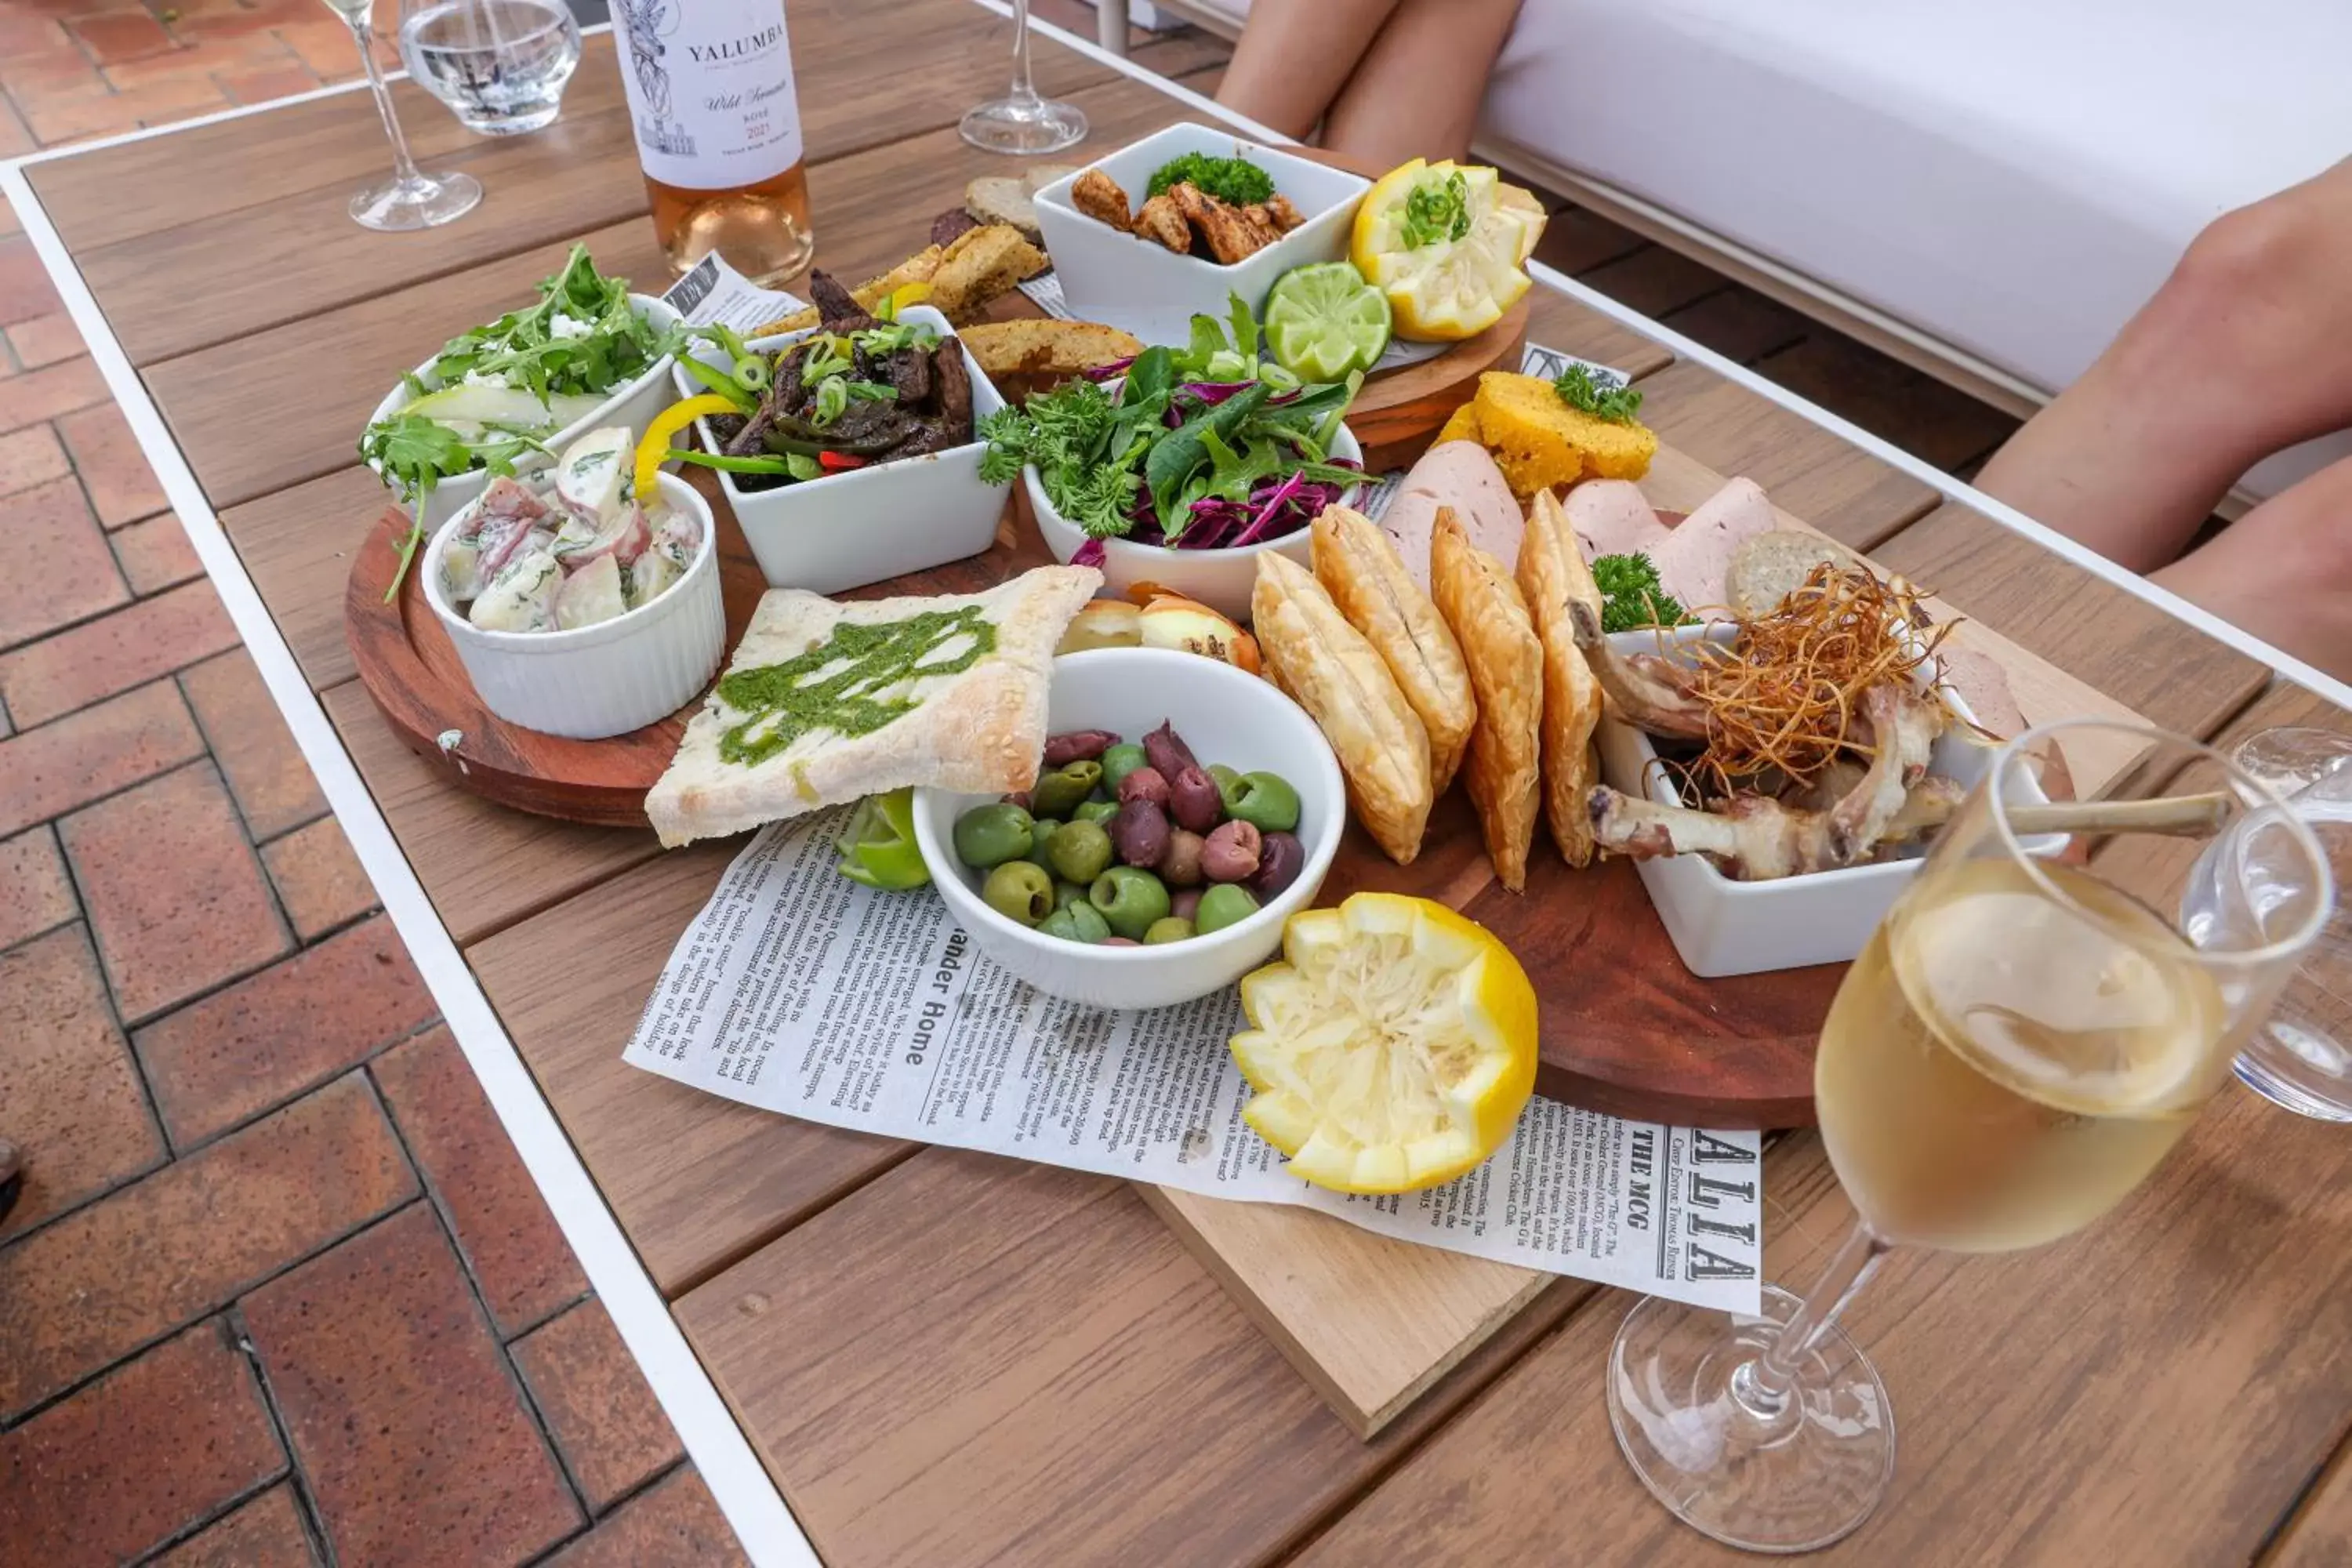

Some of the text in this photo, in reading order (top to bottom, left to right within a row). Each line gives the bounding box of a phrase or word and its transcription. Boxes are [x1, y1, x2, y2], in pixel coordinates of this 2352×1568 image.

[688, 22, 783, 62] YALUMBA
[927, 927, 937, 939] of
[932, 907, 947, 926] type
[717, 862, 817, 1076] conservation measures to protect the and
[731, 867, 830, 1081] subject to community awareness and thus, local
[736, 899, 786, 997] the architectural style
[789, 895, 850, 1022] often in Queensland, with its
[815, 901, 877, 1037] mention relocate and the
[821, 895, 893, 1061] can remove the homes intact from the
[916, 940, 935, 966] house
[644, 932, 709, 1051] in the design of holiday
[659, 904, 739, 1056] however, modern take on the
[746, 894, 834, 1085] suited to this type of dwelling. In recent
[833, 908, 902, 1065] adaptable to either uneven or steep
[673, 979, 718, 1060] homes that look
[831, 923, 909, 1106] and has corrugated tin Elevating
[848, 976, 906, 1110] from other styles of homes?
[884, 1031, 900, 1058] know
[893, 1014, 907, 1029] We
[906, 1002, 946, 1065] Home
[866, 1071, 884, 1099] today
[1068, 1061, 1087, 1102] population
[1086, 1054, 1103, 1083] roughly
[862, 1101, 872, 1112] as
[981, 1091, 995, 1122] quokka
[1064, 1104, 1073, 1115] of
[1533, 1106, 1543, 1118] the
[1508, 1127, 1526, 1203] Melbourne Cricket
[1528, 1120, 1541, 1155] Southern
[1599, 1130, 1610, 1159] Cricket
[1532, 1131, 1552, 1250] stadium in the and the
[1547, 1127, 1566, 1251] capacity in the also
[1628, 1131, 1653, 1229] THE MCG
[1684, 1127, 1757, 1281] ALIA
[1431, 1198, 1443, 1227] as two
[1446, 1214, 1457, 1229] the
[1475, 1221, 1486, 1236] The
[1520, 1210, 1531, 1227] The
[1561, 1169, 1577, 1254] over which
[1577, 1189, 1588, 1249] sports stadium
[1605, 1240, 1617, 1255] The
